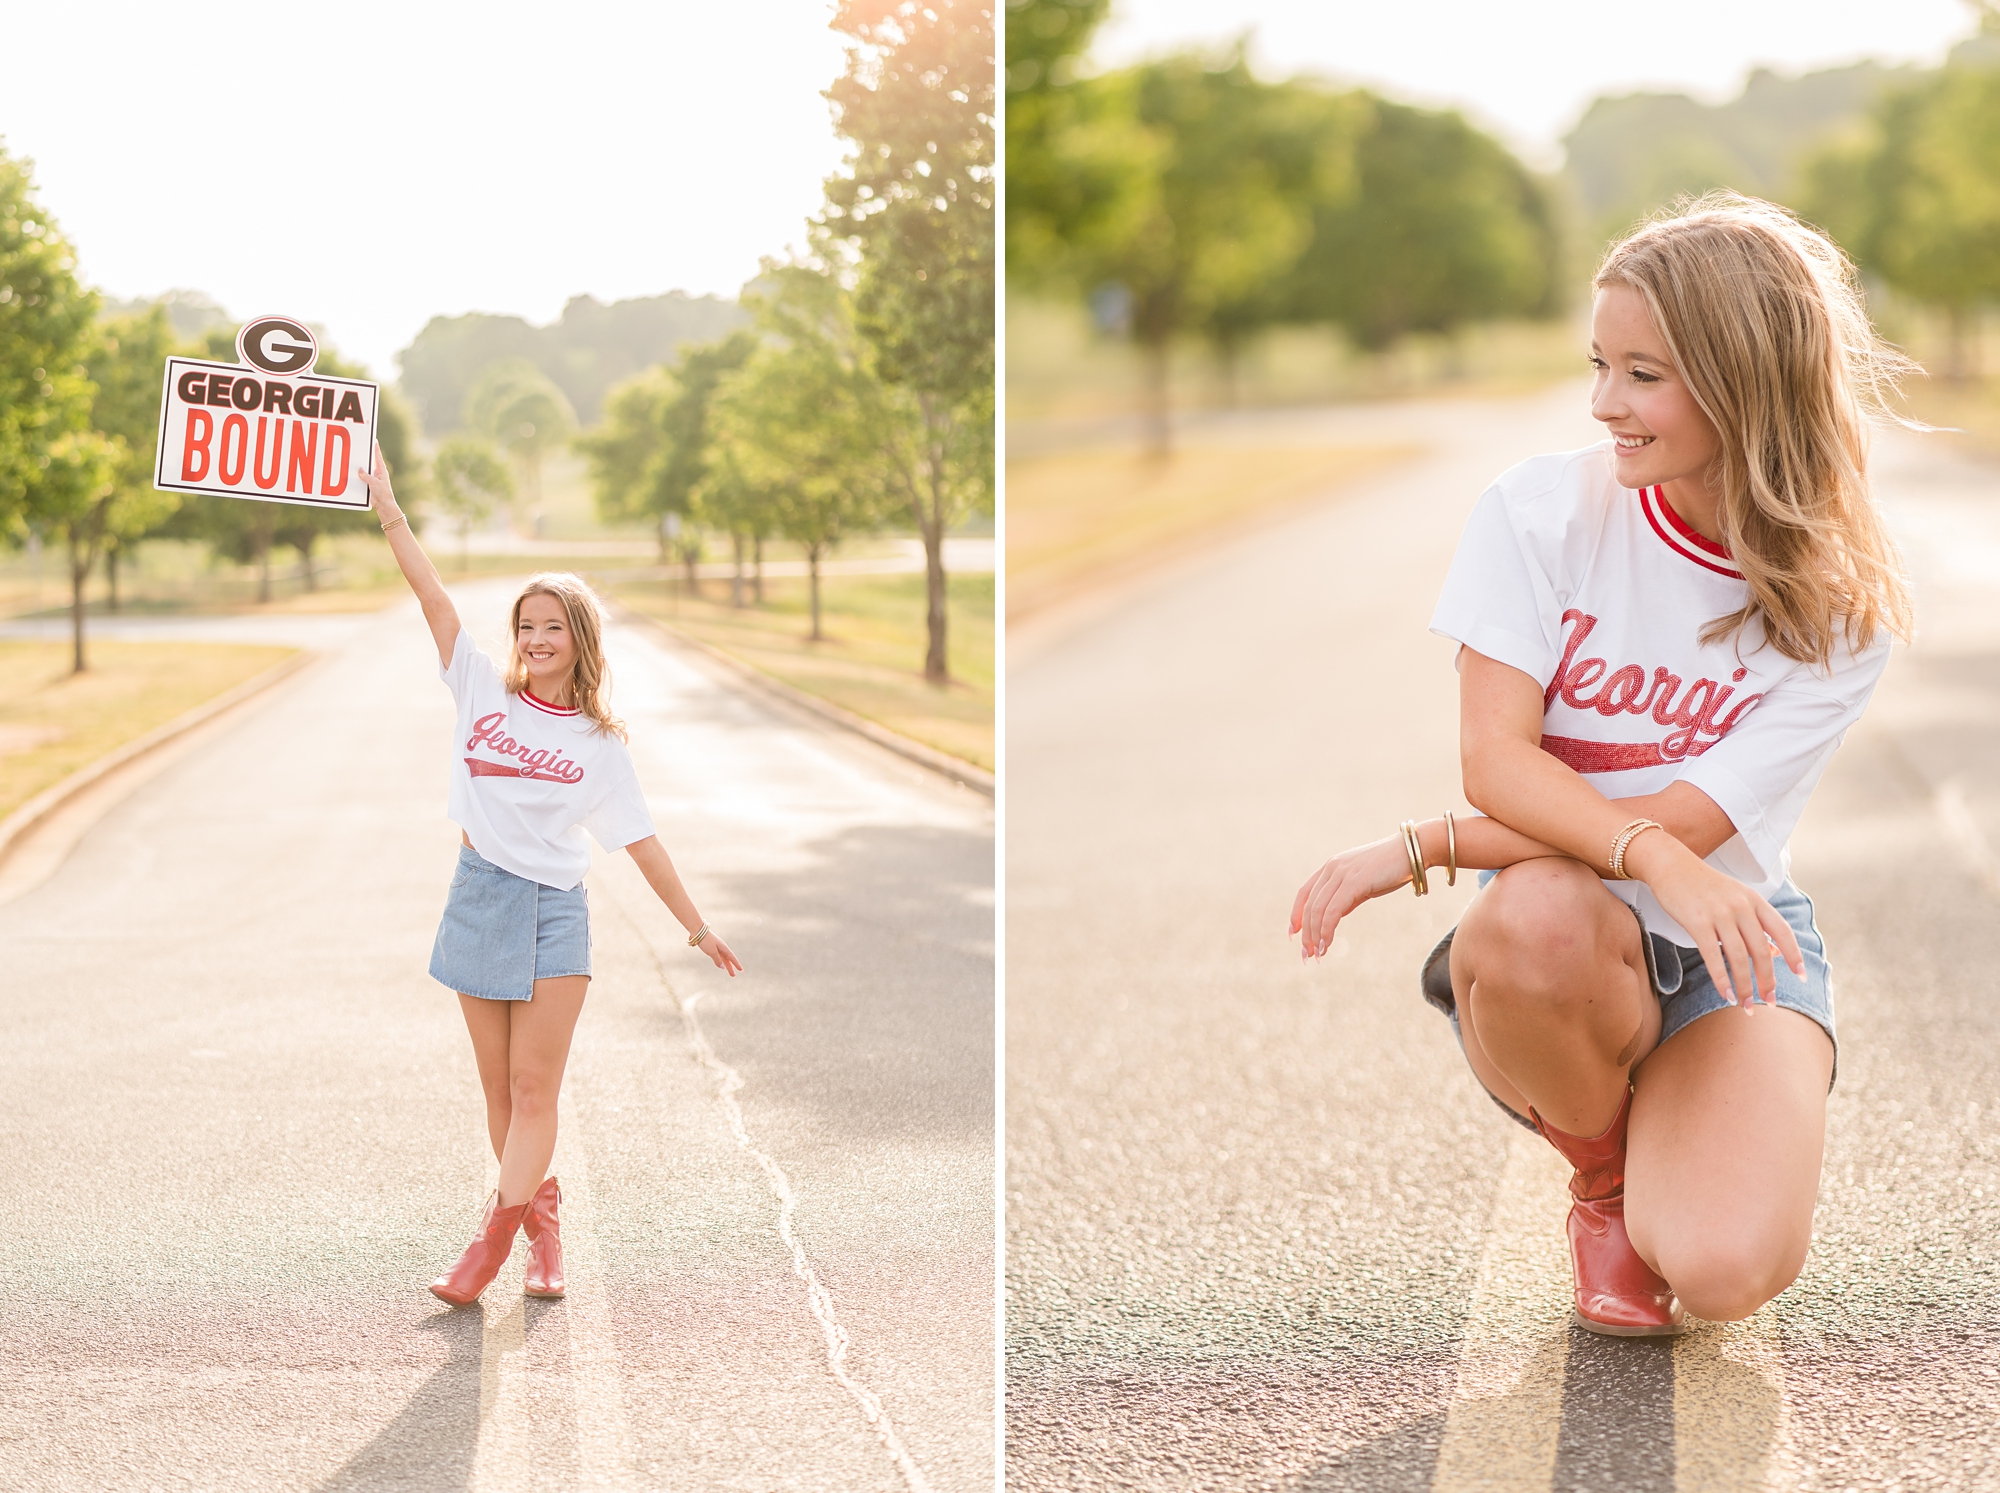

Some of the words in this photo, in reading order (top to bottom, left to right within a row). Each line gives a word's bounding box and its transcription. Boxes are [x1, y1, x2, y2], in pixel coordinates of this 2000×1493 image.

[243, 320, 314, 373] G
[177, 371, 365, 424] GEORGIA
[181, 408, 352, 497] BOUND
[466, 711, 585, 780] Georgia
